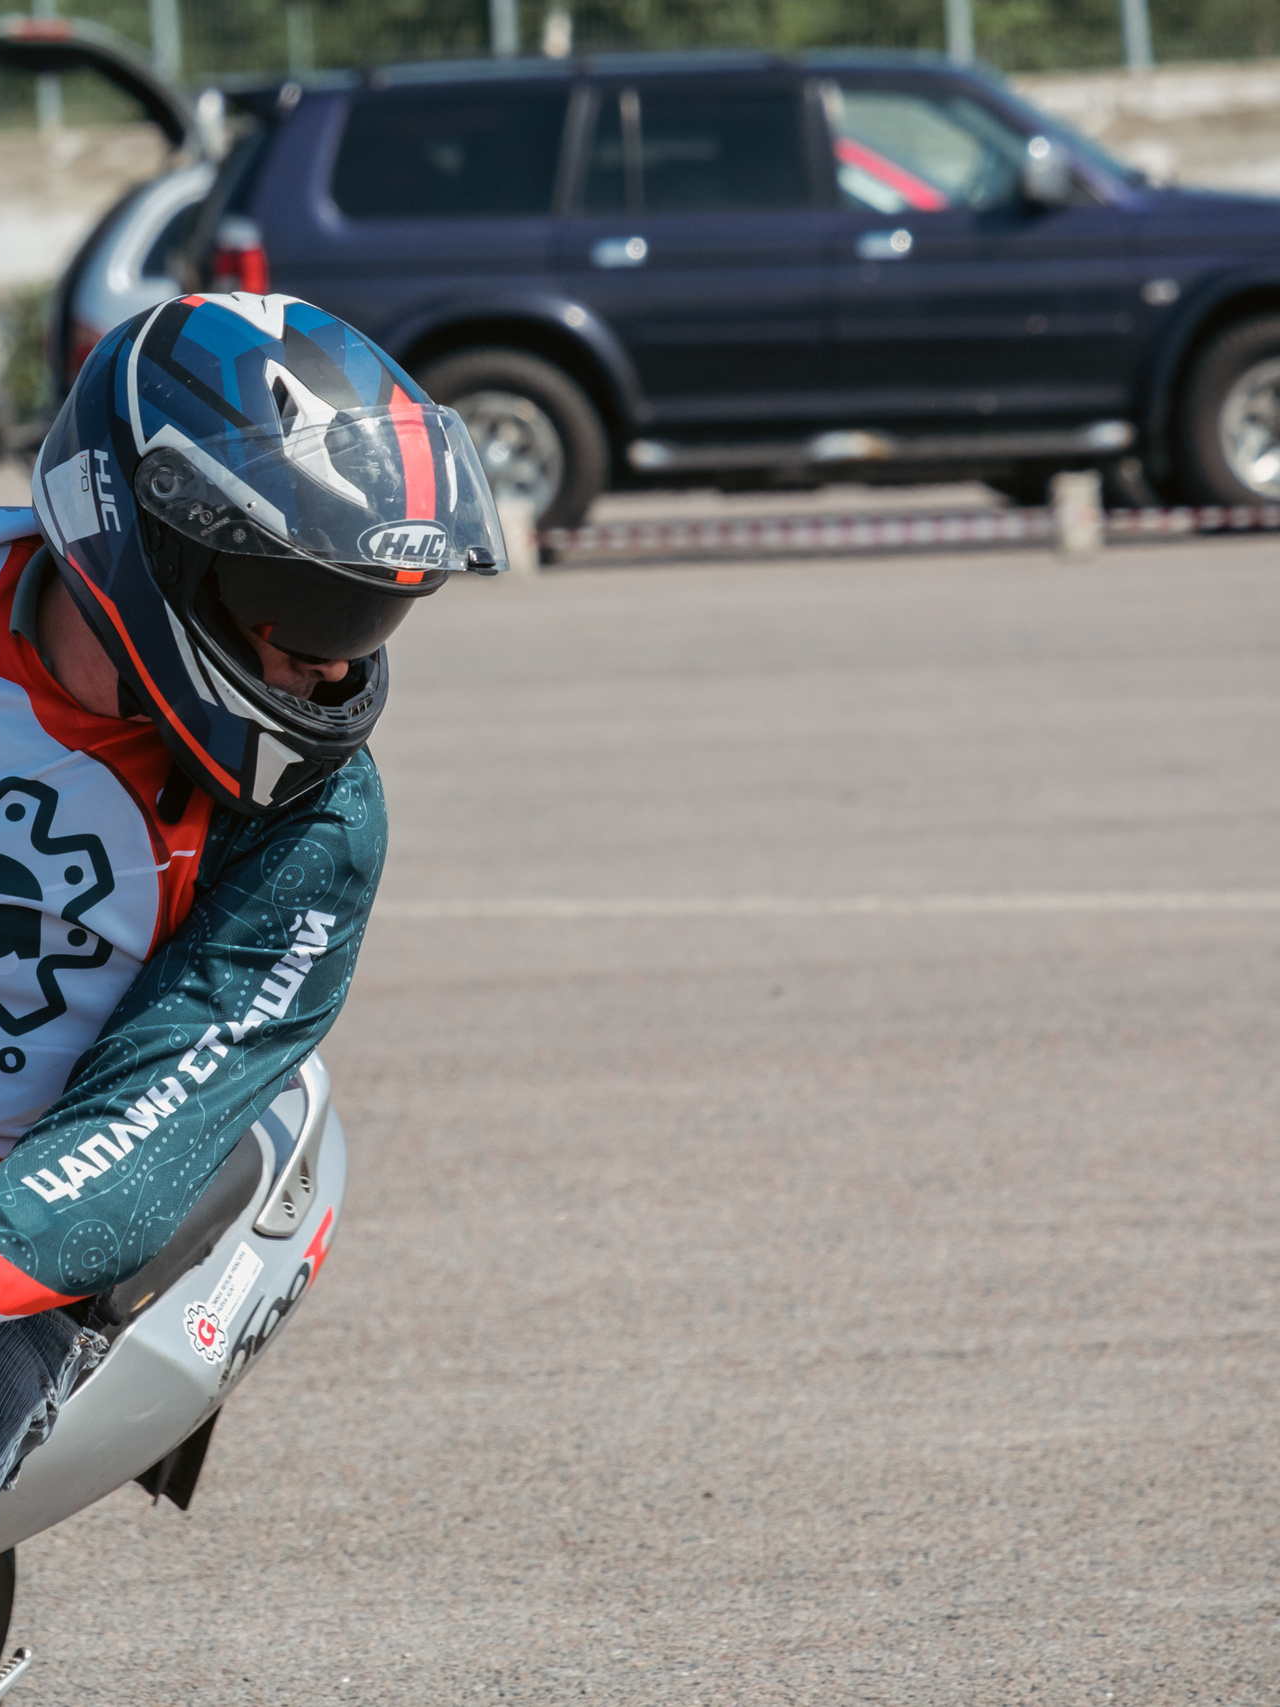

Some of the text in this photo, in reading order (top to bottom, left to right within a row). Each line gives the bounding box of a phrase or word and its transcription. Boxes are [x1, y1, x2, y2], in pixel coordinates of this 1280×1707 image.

[80, 454, 89, 492] i70
[94, 449, 121, 532] HJC
[373, 532, 445, 565] HJC
[21, 1076, 189, 1204] ЦАПЛИН
